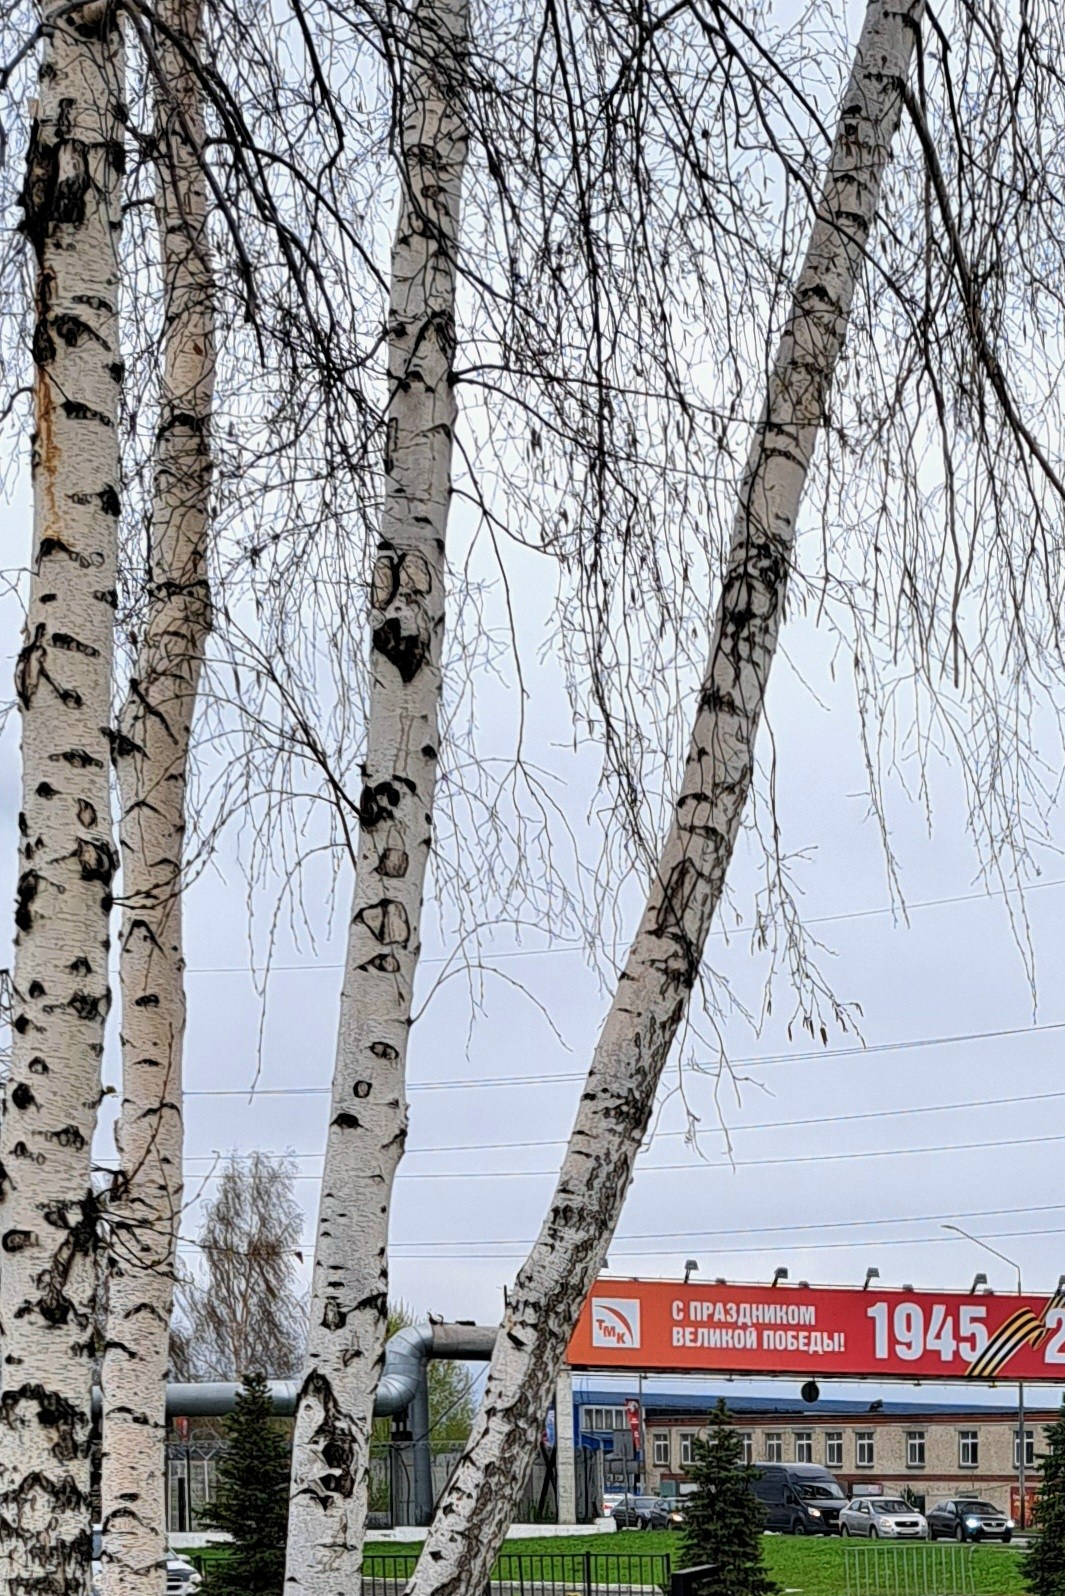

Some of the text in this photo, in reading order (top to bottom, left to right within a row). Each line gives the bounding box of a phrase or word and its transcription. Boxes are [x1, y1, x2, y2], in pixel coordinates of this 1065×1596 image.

[672, 1300, 816, 1327] С ПРАЗДНИКОМ
[595, 1318, 628, 1346] ТМК
[672, 1326, 846, 1355] ВЕЛИКОЙ ПОБЕДЫ!
[866, 1302, 989, 1363] 1945
